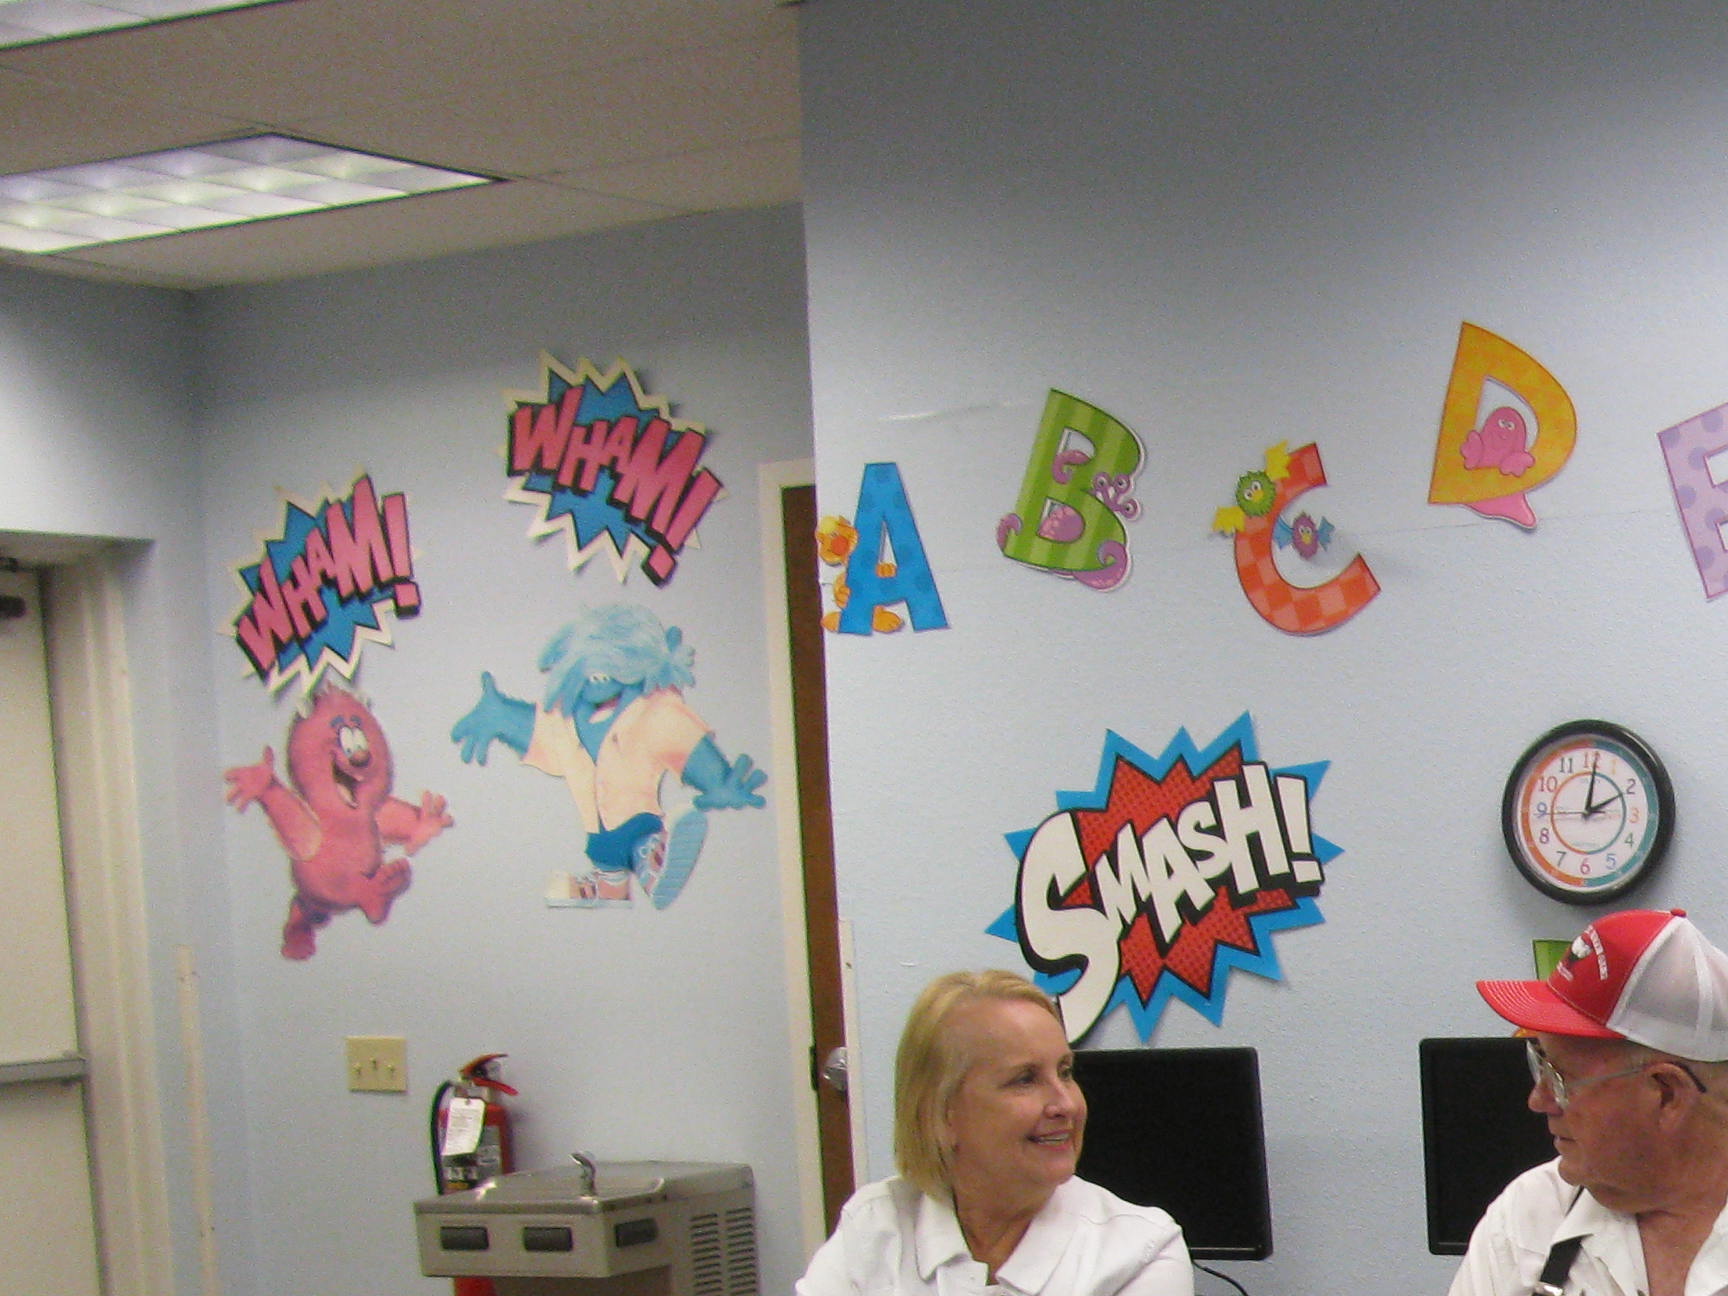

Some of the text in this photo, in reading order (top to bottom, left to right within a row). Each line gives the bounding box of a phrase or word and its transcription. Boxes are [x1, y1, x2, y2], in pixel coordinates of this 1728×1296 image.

[1428, 321, 1577, 505] D
[508, 386, 724, 585] WHAM!
[1003, 388, 1139, 571] B
[1232, 443, 1382, 635] C
[837, 462, 950, 635] A
[236, 474, 421, 681] WHAM!
[1560, 757, 1574, 774] 11
[1583, 751, 1600, 769] 12
[1610, 760, 1618, 775] 1
[1538, 775, 1558, 793] 10
[1625, 778, 1637, 795] 2
[1536, 802, 1548, 818] 9
[1628, 810, 1640, 824] 3
[1539, 827, 1550, 844] 8
[1624, 832, 1635, 848] 4
[1556, 851, 1567, 867] 7
[1580, 857, 1591, 874] 6
[1606, 853, 1617, 870] 5
[1016, 762, 1325, 1045] SMASH!
